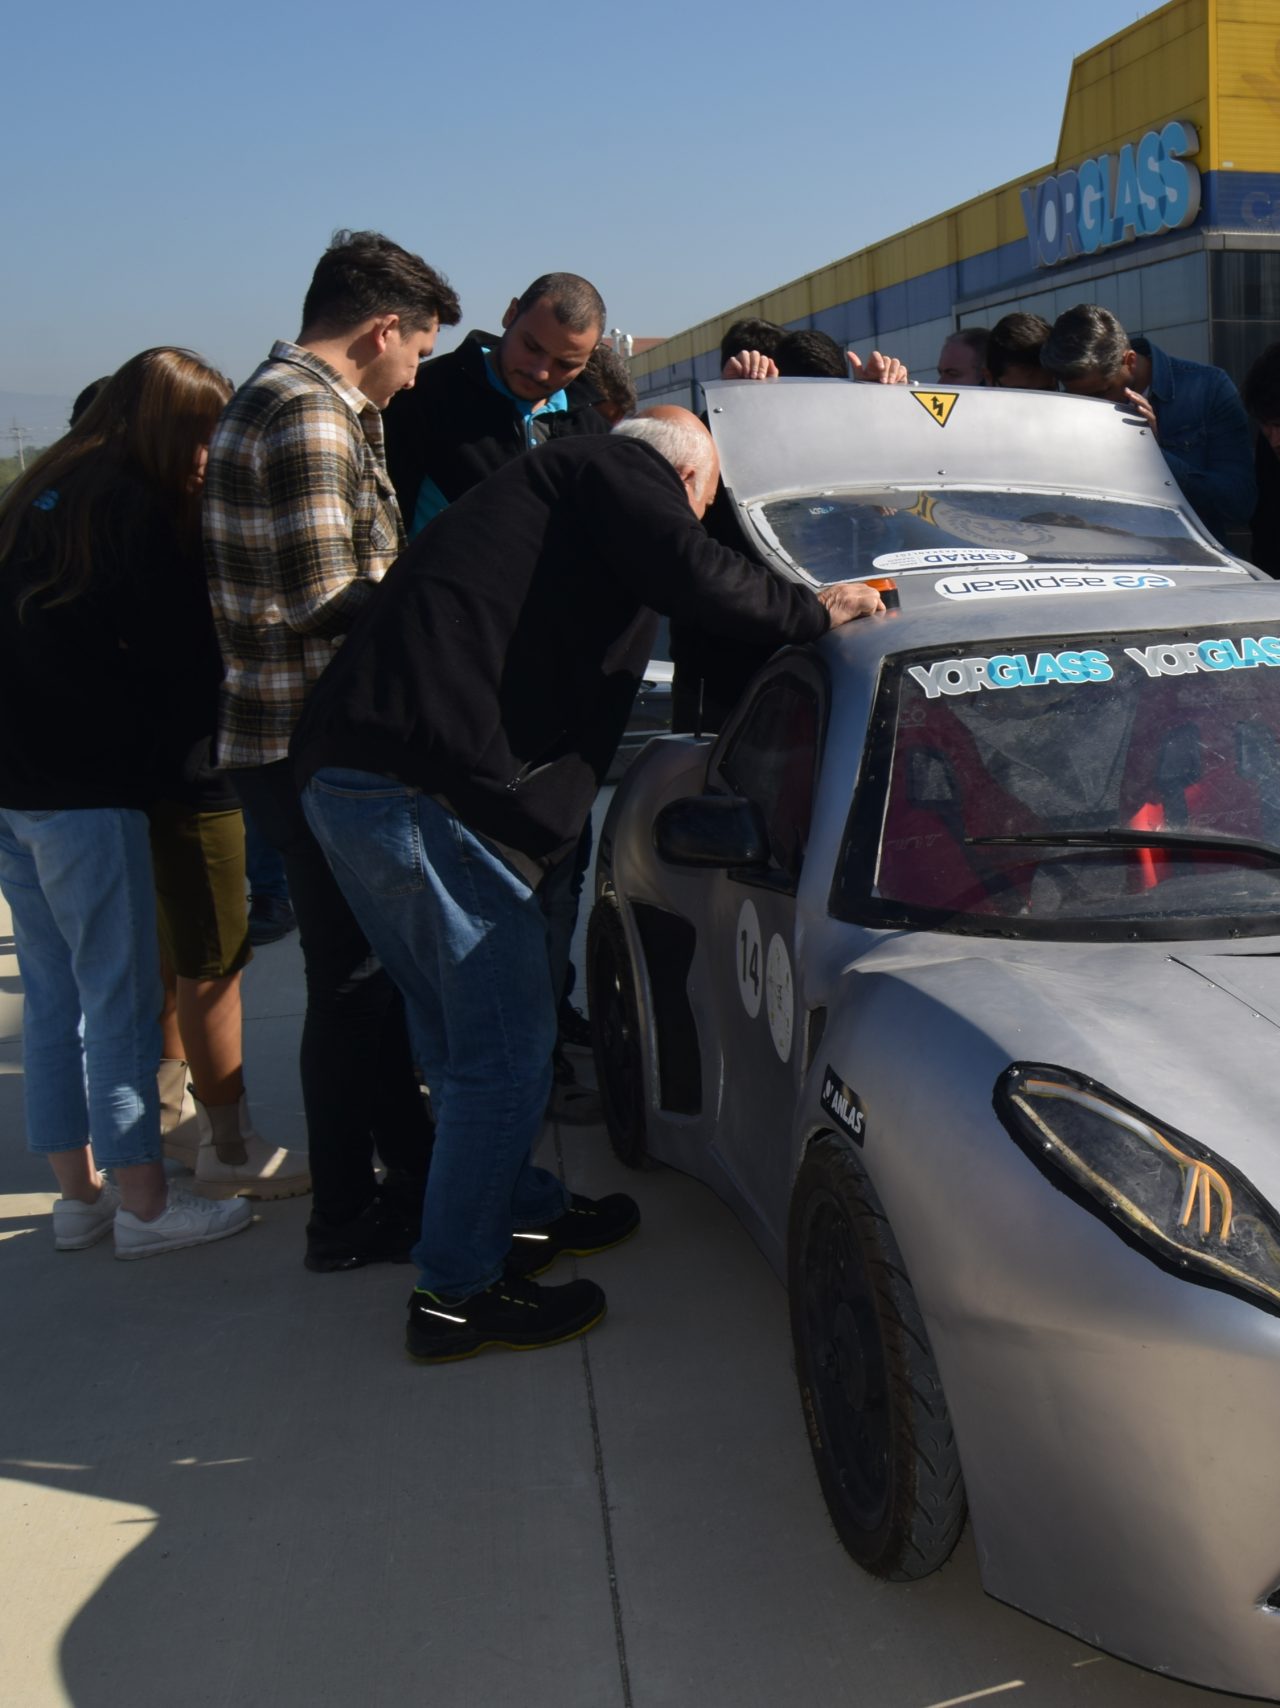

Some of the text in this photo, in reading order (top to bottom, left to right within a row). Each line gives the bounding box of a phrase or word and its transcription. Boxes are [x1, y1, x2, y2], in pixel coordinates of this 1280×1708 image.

[1020, 121, 1201, 270] YORGLASS
[943, 576, 1107, 595] aspilsan
[908, 650, 1115, 699] YORGLASS
[740, 929, 759, 997] 14
[830, 1092, 864, 1135] ANLAS
